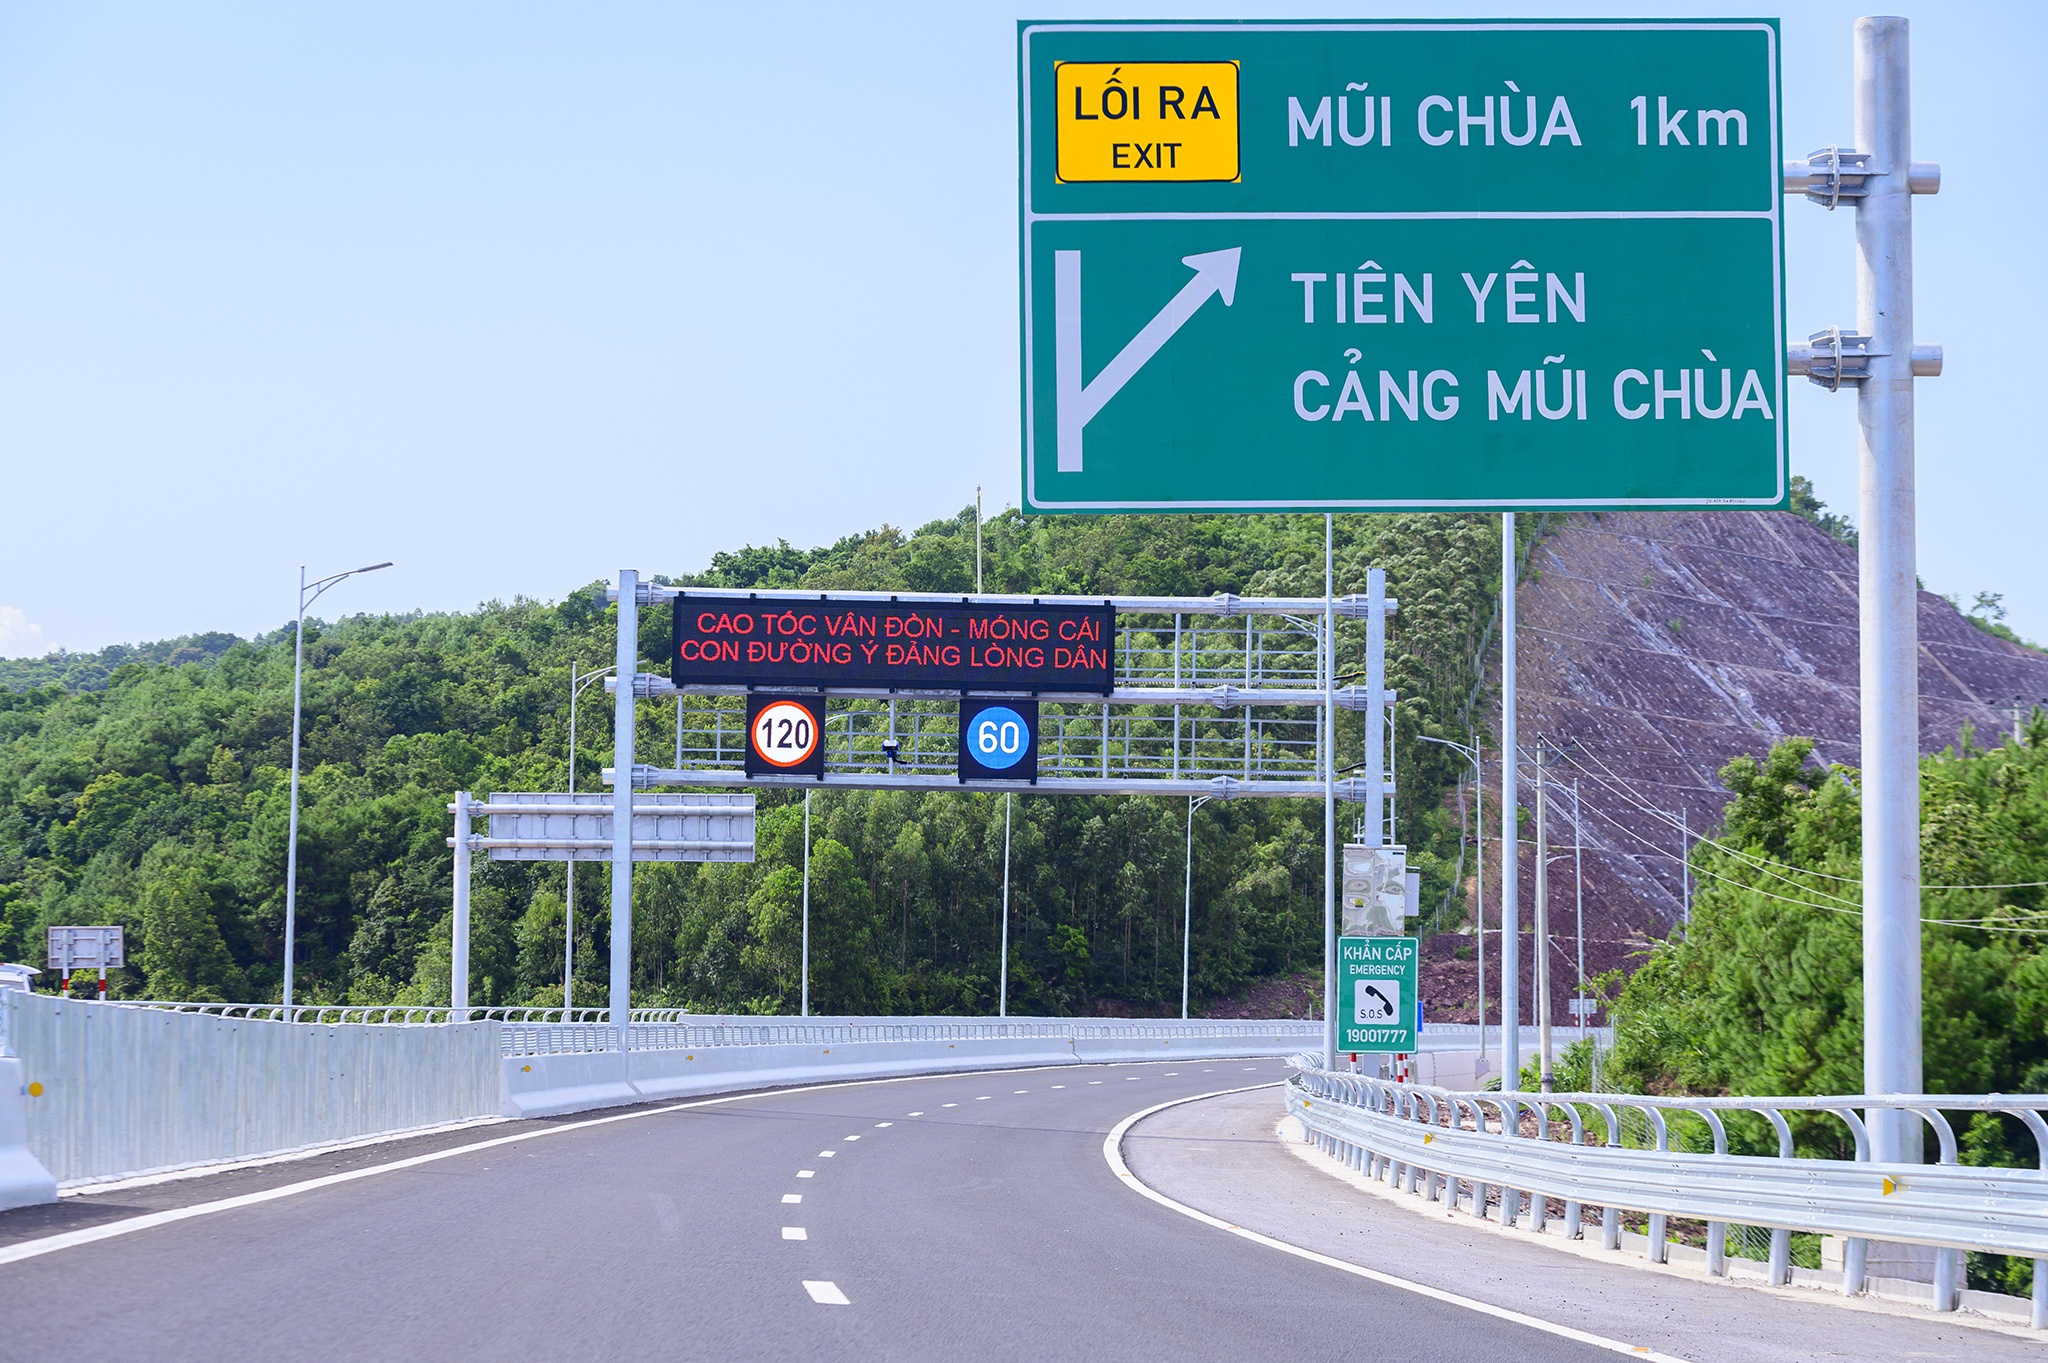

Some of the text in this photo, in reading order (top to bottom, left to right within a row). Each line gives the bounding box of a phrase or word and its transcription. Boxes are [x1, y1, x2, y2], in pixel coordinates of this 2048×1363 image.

[1074, 67, 1221, 120] LỐI RA
[1288, 81, 1748, 147] MŨI CHÙA 1km
[1112, 143, 1182, 169] EXIT
[1292, 259, 1586, 324] TIÊN YÊN
[1293, 349, 1774, 421] CẢNG MŨI CHÙA
[697, 612, 754, 635] CAO
[761, 610, 817, 636] TỐC
[825, 611, 877, 637] VÂN
[969, 614, 1049, 641] MÓNG
[1058, 616, 1100, 641] CÁI
[680, 638, 1107, 670] CON ĐƯỜNG Ý ĐẢNG LÒNG DÂN
[762, 718, 810, 749] 120
[978, 720, 1020, 754] 60
[1344, 938, 1413, 961] KHẨN CẤP
[1349, 964, 1406, 976] EMERGENCY
[1346, 1028, 1408, 1044] 19001777
